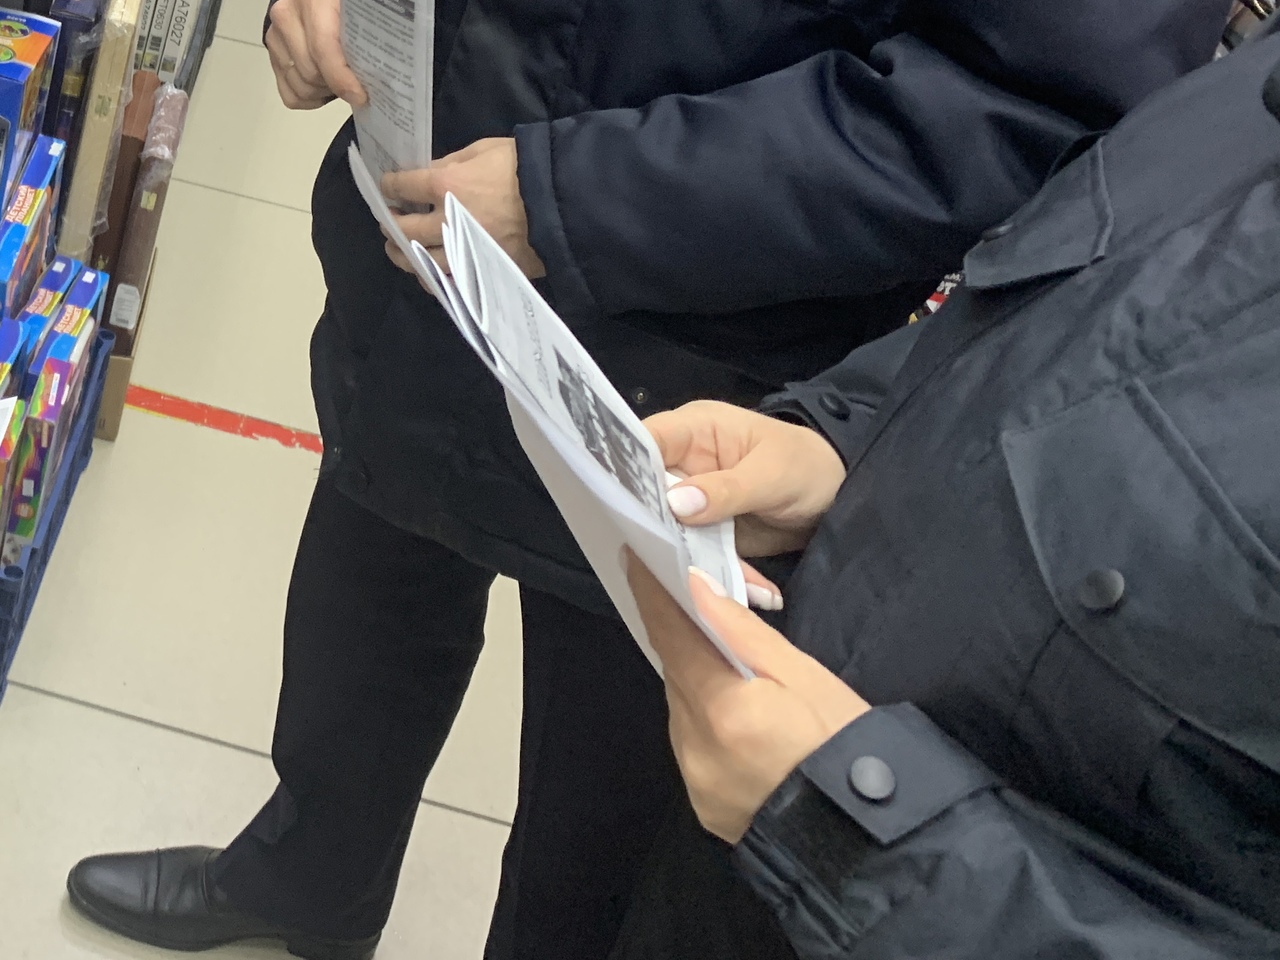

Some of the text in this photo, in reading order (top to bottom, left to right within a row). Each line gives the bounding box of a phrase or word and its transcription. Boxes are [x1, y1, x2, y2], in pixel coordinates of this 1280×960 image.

[5, 185, 29, 222] ДЕТСКИЙ
[16, 189, 35, 223] ПЛАНШЕТ
[25, 288, 47, 314] ДЕТСКИЙ
[34, 291, 54, 315] ПЛАНШЕТ
[53, 304, 75, 332] ДЕТСКИЙ
[63, 308, 83, 334] ПЛАНШЕТ
